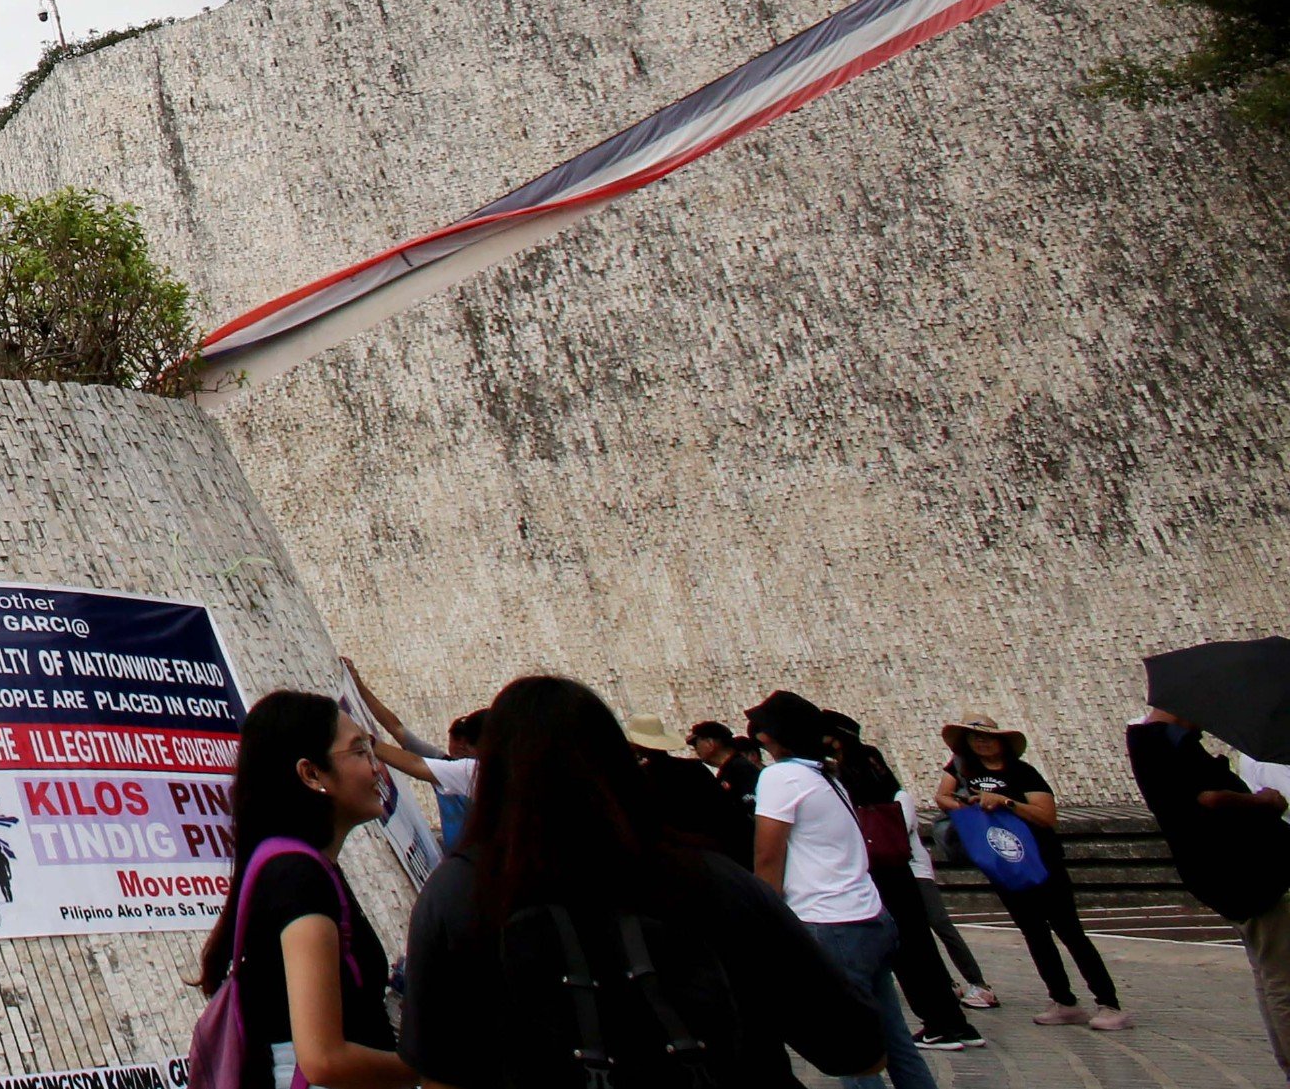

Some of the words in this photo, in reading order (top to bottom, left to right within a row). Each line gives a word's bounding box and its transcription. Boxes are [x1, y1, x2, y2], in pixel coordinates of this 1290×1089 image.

[3, 614, 91, 638] GARCI@
[38, 649, 64, 676] OF
[70, 651, 174, 683] NATIONWIDE
[172, 659, 225, 688] FRAUD
[52, 689, 89, 710] ARE
[94, 691, 163, 715] PLACED
[164, 695, 186, 717] IN
[187, 698, 235, 720] GOVT.
[29, 729, 179, 768] ILLEGITIMATE
[23, 780, 149, 817] KILOS
[167, 782, 234, 816] PIN
[30, 823, 178, 859] TINDIG
[117, 870, 232, 898] Moveme
[59, 906, 113, 923] Pilipino
[117, 904, 143, 918] Ako
[146, 903, 176, 918] Para
[178, 903, 196, 917] Sa
